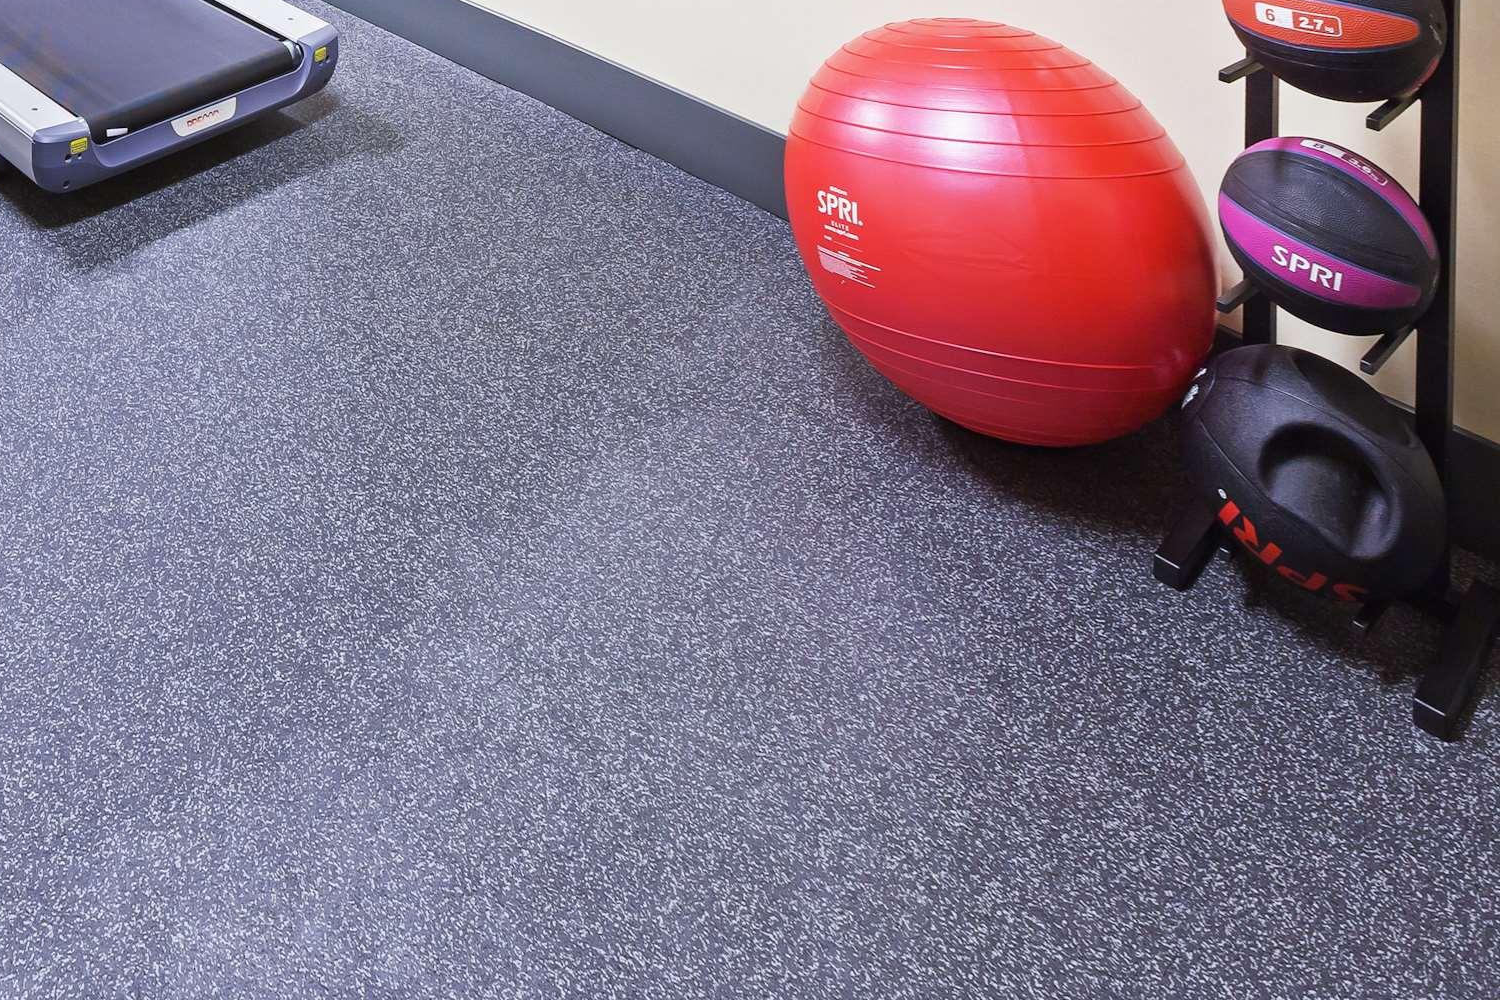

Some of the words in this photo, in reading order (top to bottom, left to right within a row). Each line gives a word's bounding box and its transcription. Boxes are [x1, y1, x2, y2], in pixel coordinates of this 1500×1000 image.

[1266, 9, 1275, 21] 6
[1299, 16, 1324, 30] 2.7
[1271, 245, 1342, 291] SPRI
